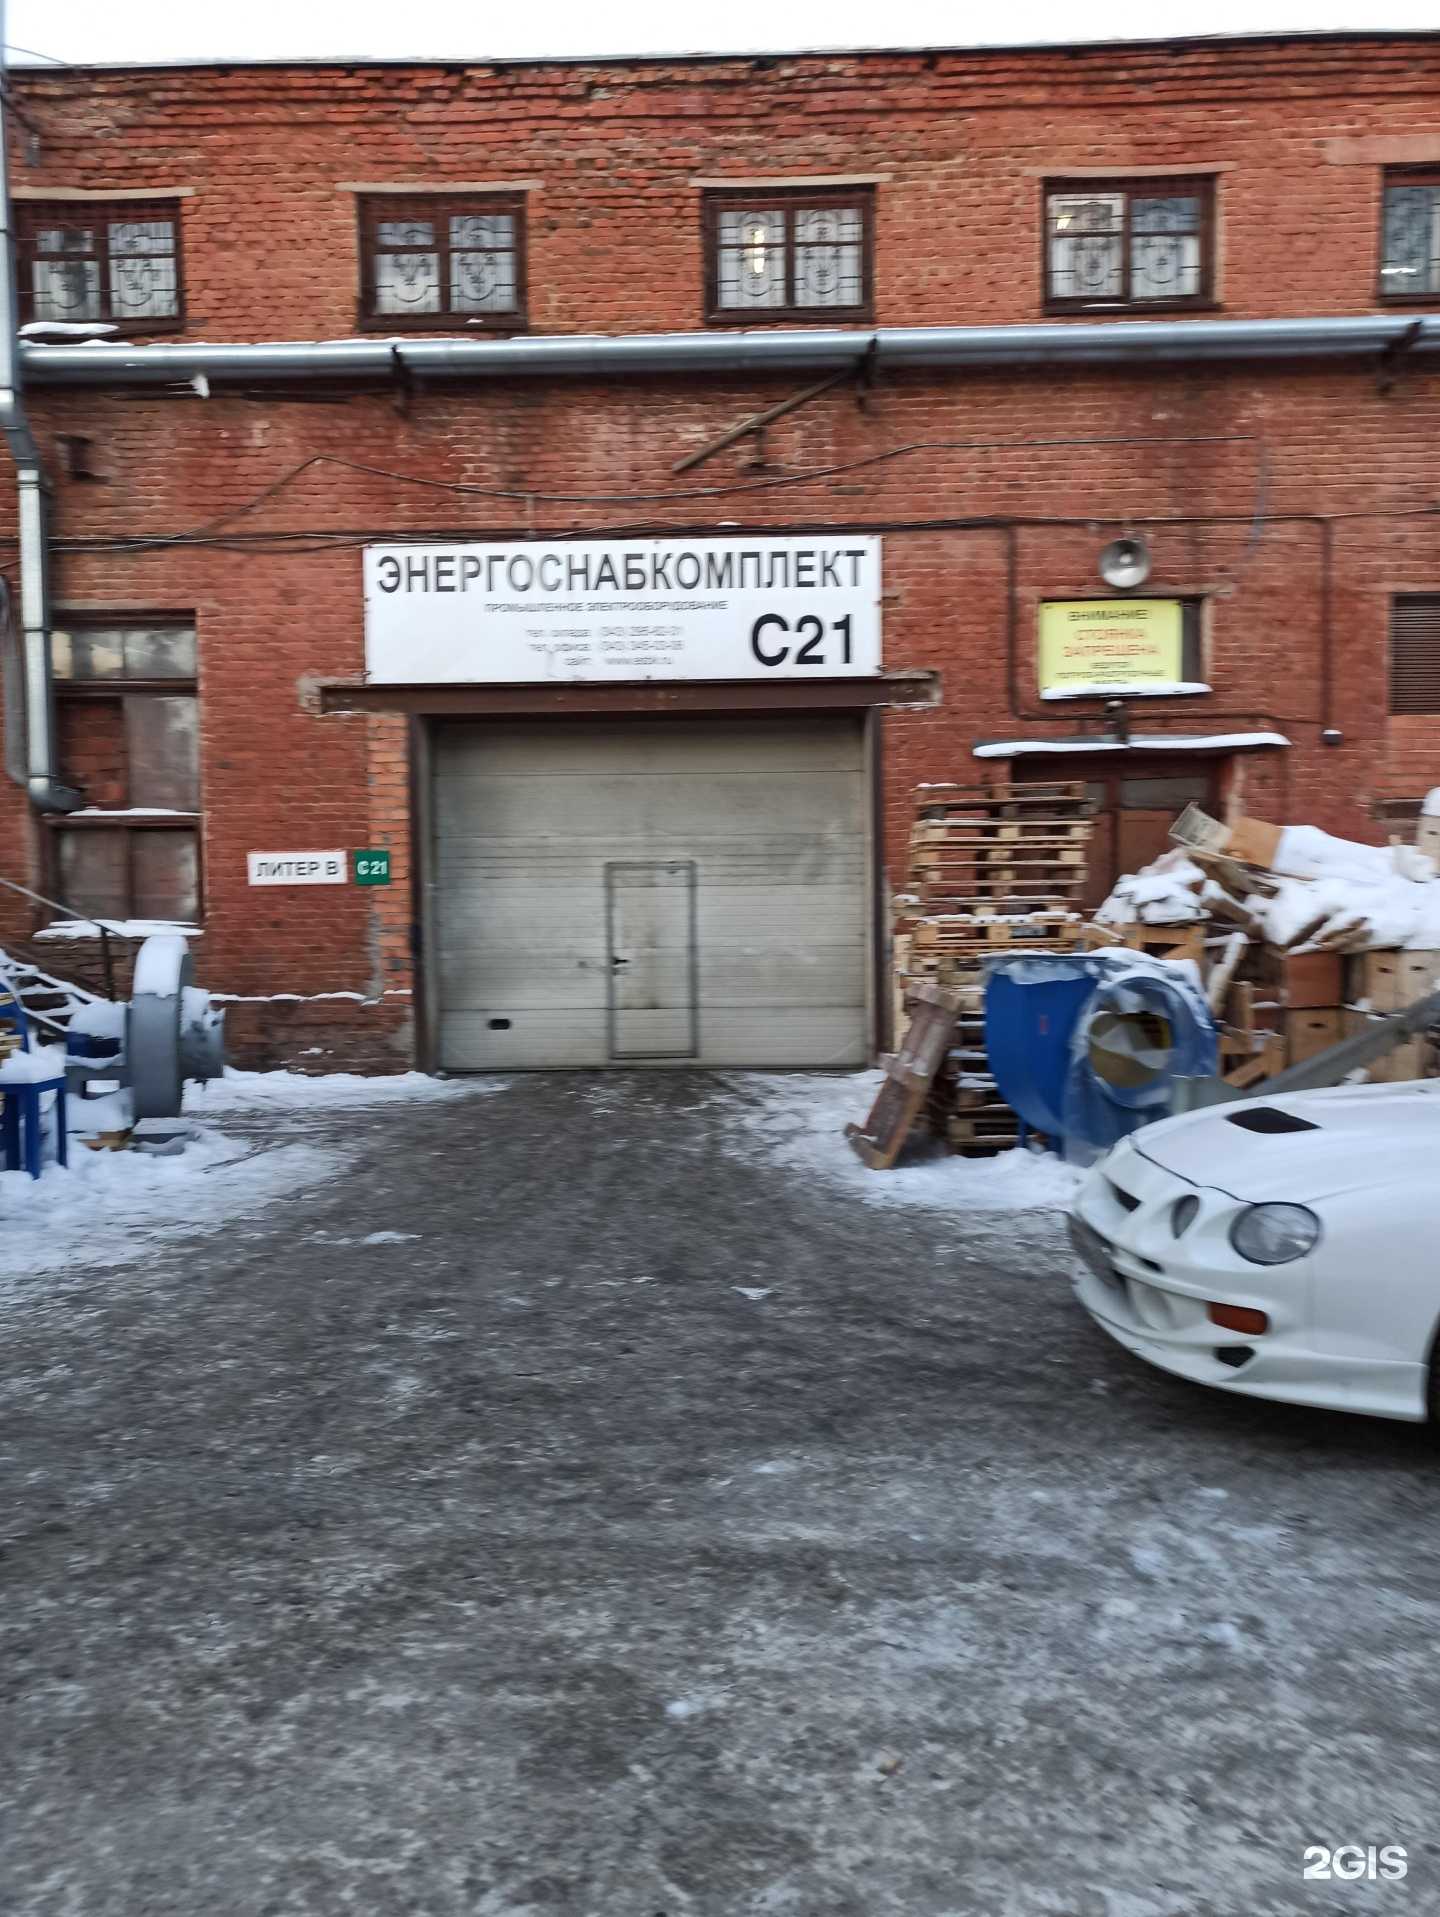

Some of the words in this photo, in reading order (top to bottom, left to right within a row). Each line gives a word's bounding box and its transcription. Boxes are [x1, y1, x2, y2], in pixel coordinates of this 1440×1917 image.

[378, 550, 866, 593] ЭНЕРГОСНАБКОМПЛЕКТ
[484, 602, 583, 613] ПРОМЫШЛЕННОЕ
[585, 601, 728, 613] ЭЛЕКТРООБОРУДОВАНИЕ
[752, 614, 851, 666] С21
[257, 862, 320, 877] ЛИТЕР
[326, 861, 338, 875] В
